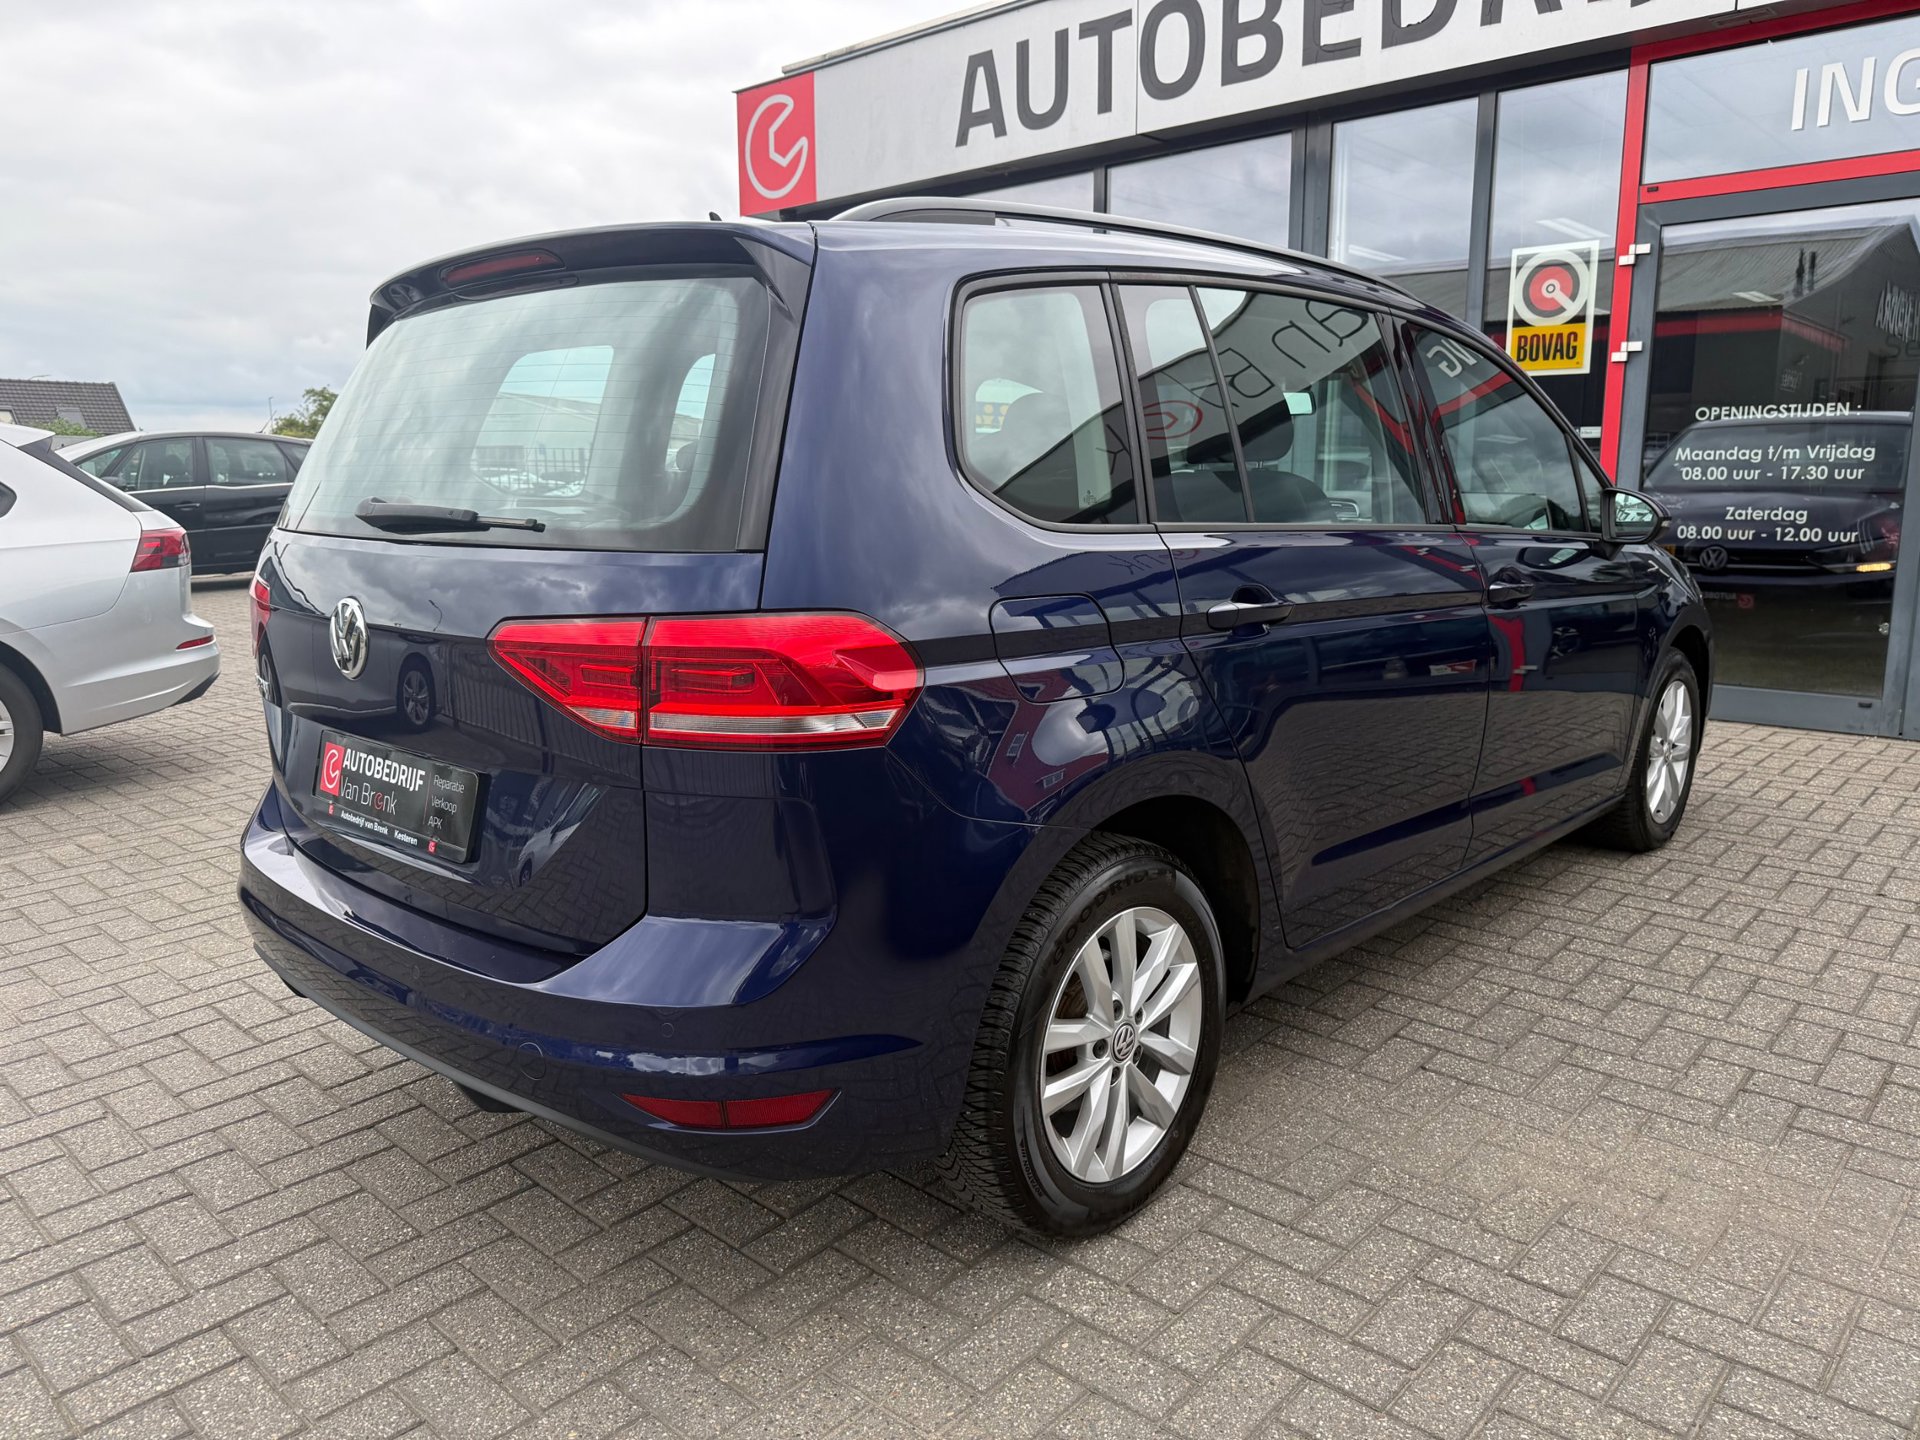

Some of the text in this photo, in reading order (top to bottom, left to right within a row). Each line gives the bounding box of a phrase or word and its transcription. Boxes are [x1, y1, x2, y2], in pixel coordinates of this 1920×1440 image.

[1517, 331, 1578, 362] BOVAG
[1695, 402, 1850, 421] OPENINGSTIJDEN
[1675, 444, 1876, 463] Maandag t/m Vrijdag
[1681, 466, 1727, 481] 08.00
[1733, 468, 1761, 480] uur
[1780, 465, 1828, 480] 17.30
[1834, 467, 1865, 480] uur
[1725, 507, 1808, 524] Zaterdag
[1677, 525, 1722, 540] 08.00
[1727, 528, 1756, 540] uur
[1775, 527, 1822, 542] 12.00
[1827, 530, 1858, 543] uur
[342, 748, 426, 792] AUTOBEDRIJF
[340, 775, 359, 802] Van
[433, 774, 465, 793] Reparatie
[431, 796, 457, 815] Verkoop
[340, 809, 365, 828] Autobedrijf
[428, 815, 443, 830] APK
